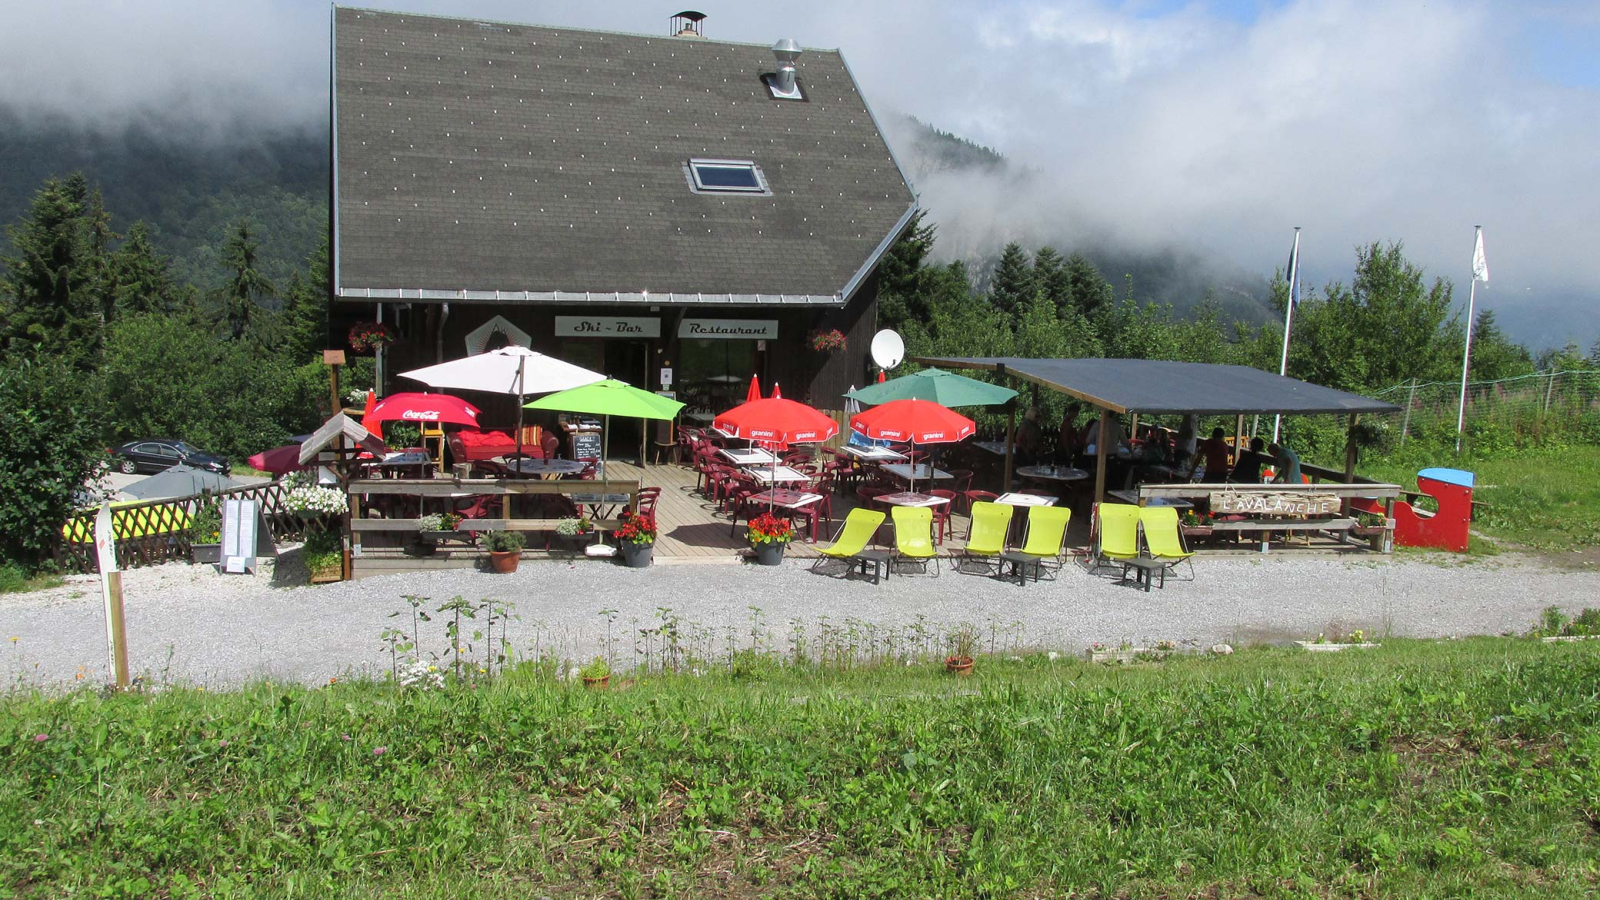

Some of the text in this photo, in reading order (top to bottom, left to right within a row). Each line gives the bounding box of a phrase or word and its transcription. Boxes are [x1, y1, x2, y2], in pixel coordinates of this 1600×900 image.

[573, 321, 602, 332] Ski
[616, 321, 643, 333] Bar
[689, 323, 768, 334] Restaurant
